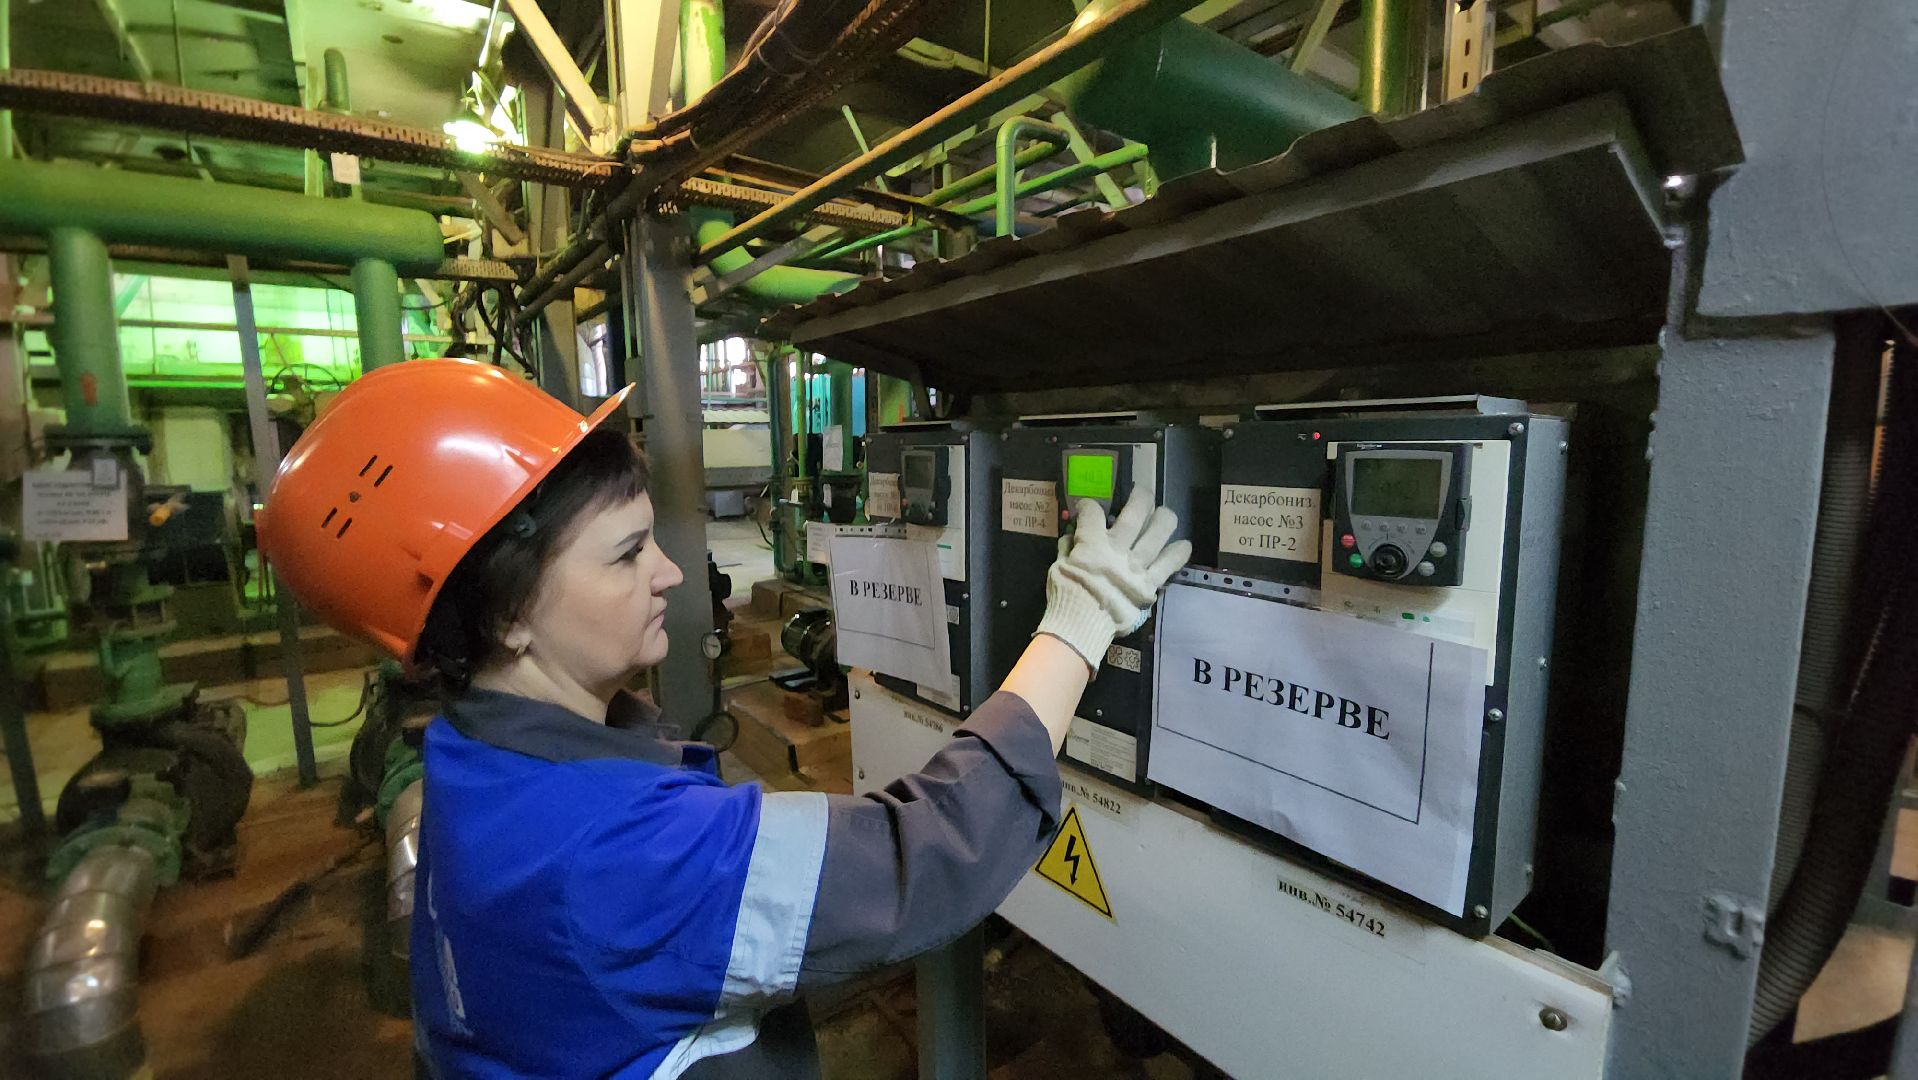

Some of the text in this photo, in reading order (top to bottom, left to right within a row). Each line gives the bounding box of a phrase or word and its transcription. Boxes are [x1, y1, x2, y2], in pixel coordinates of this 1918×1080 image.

[1010, 501, 1031, 511] насос
[1013, 517, 1022, 527] от
[1234, 514, 1304, 529] насос №3
[1239, 534, 1297, 551] от ПР-2
[849, 580, 922, 606] В РЕЗЕРВЕ
[1192, 657, 1391, 741] В РЕЗЕРВЕ
[1092, 793, 1121, 815] 54822
[1278, 880, 1385, 937] инв.№ 54742
